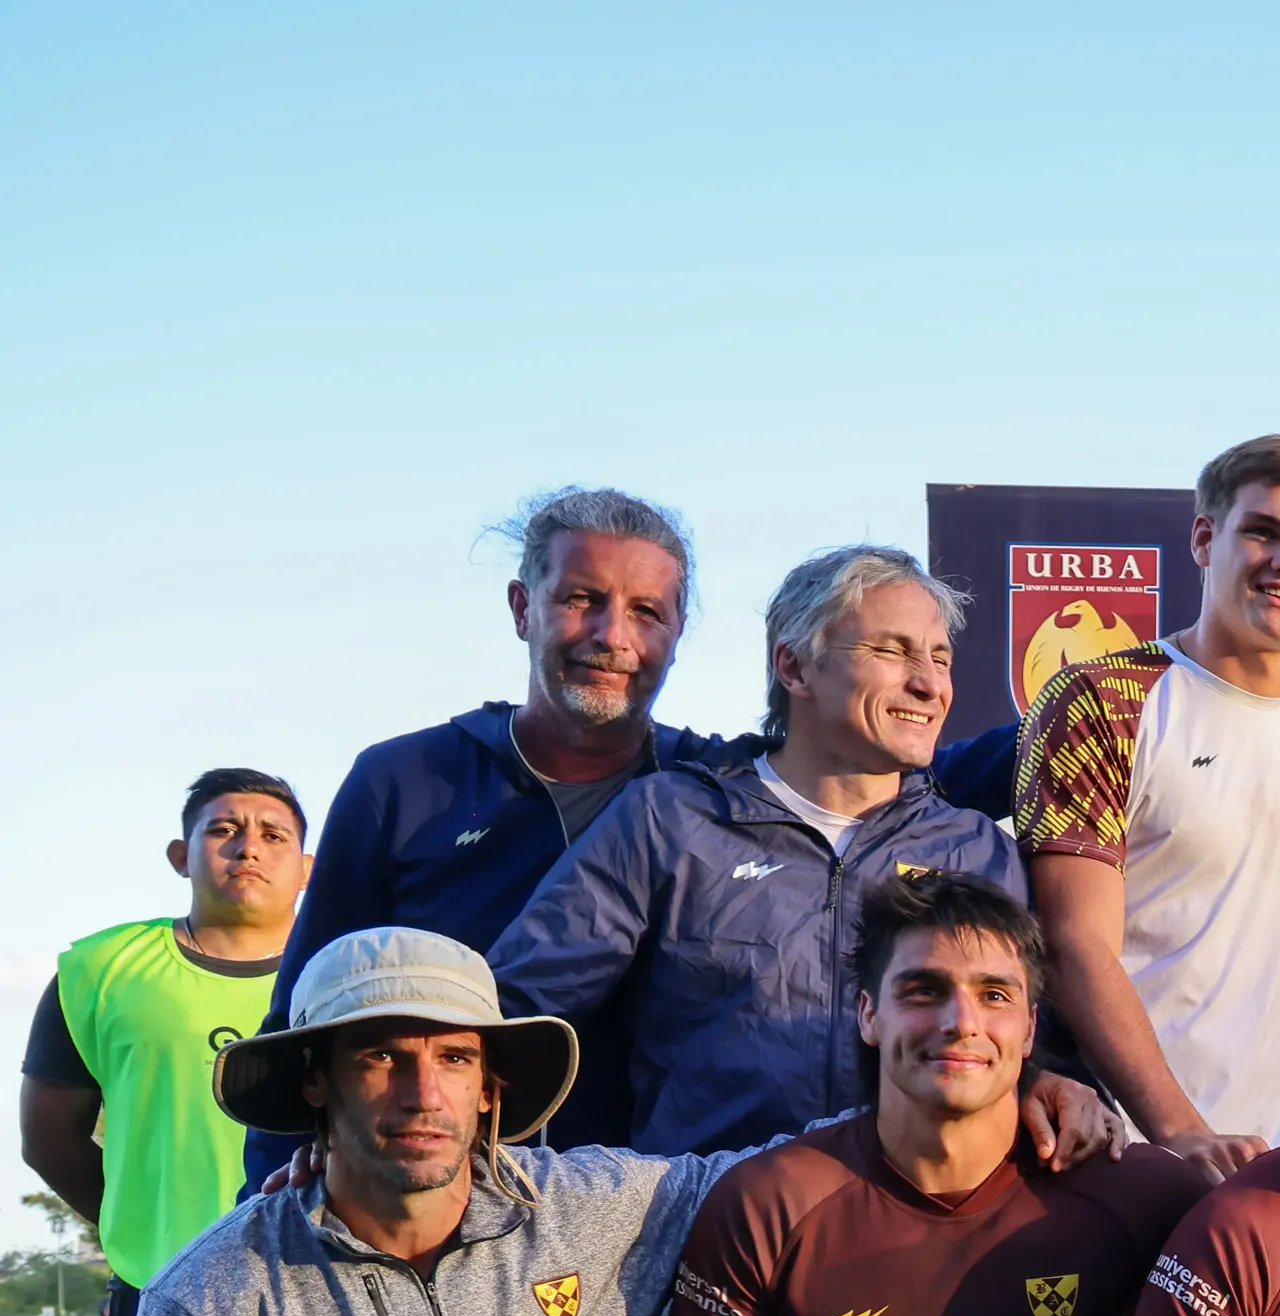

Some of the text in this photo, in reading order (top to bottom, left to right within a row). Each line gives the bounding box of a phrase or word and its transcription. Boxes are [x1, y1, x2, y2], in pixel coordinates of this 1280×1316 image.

[1025, 552, 1144, 580] URBA
[1060, 584, 1085, 592] RUGBY
[1096, 585, 1124, 593] BUENOS
[1156, 1253, 1231, 1310] universal
